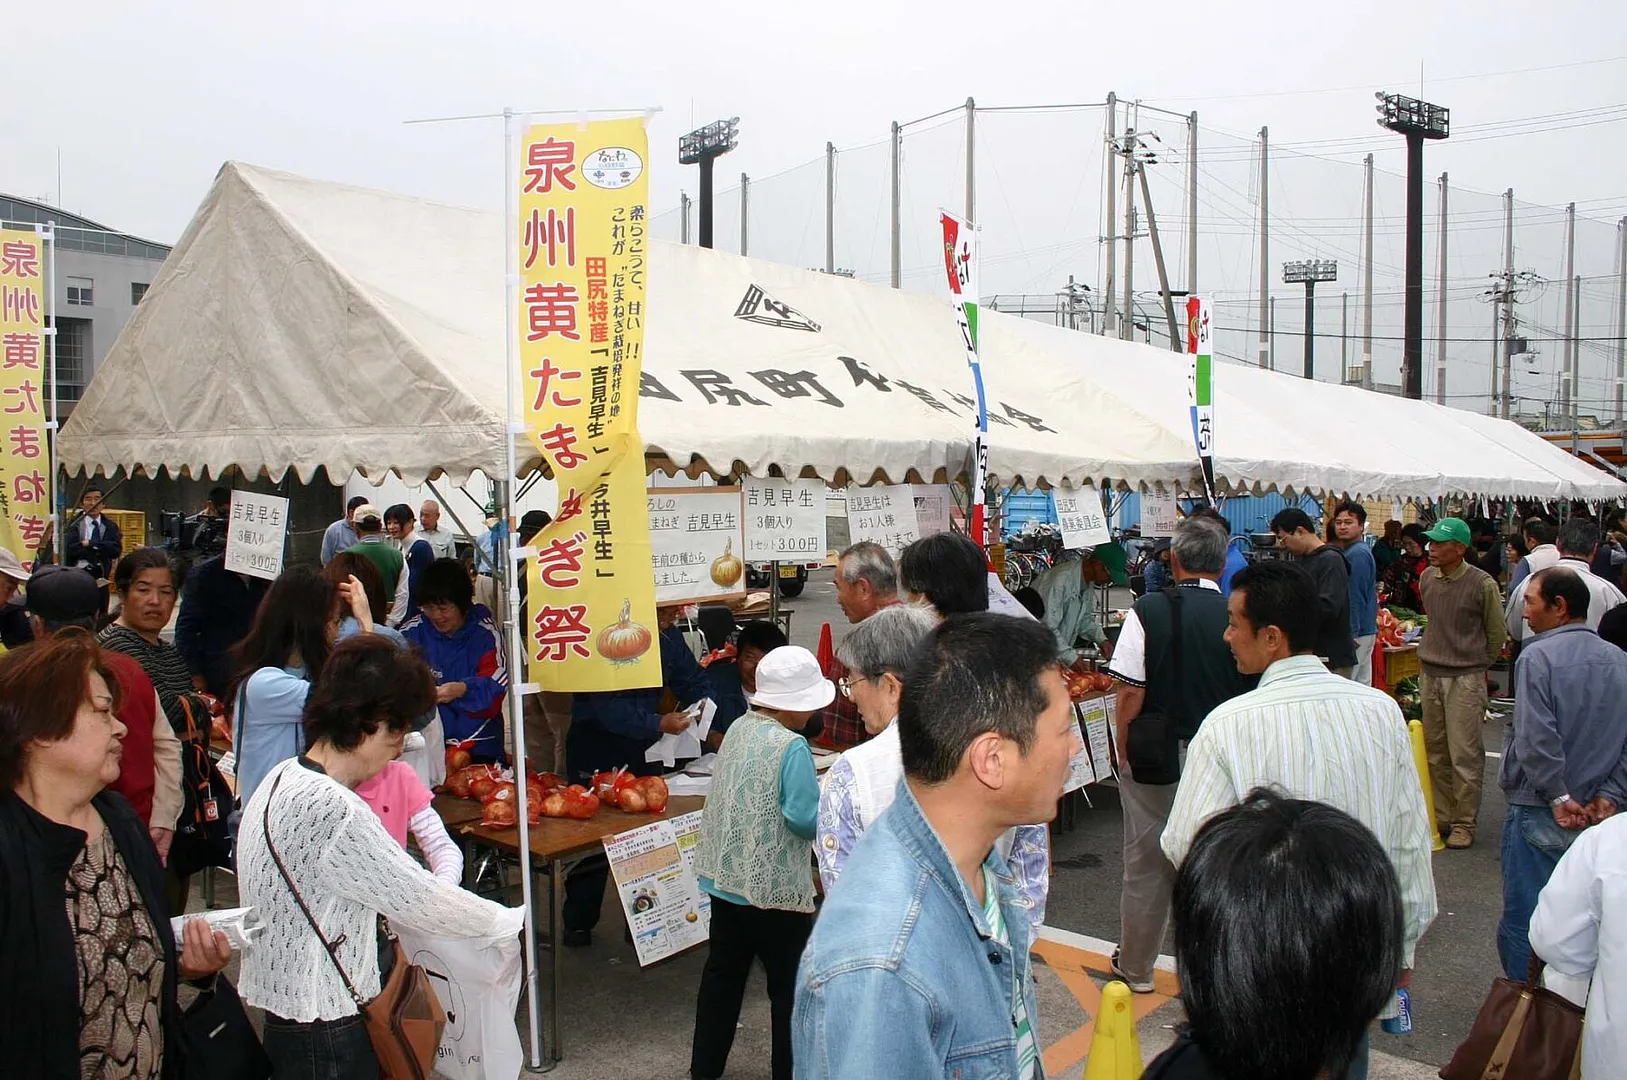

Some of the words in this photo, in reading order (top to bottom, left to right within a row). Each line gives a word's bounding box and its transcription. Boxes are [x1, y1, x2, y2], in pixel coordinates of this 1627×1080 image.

[747, 488, 814, 507] 吉見早生
[850, 495, 892, 510] 吉見早生は
[234, 501, 280, 526] 吉見早生
[687, 512, 736, 530] 吉見早生
[757, 515, 793, 529] 3個入り
[238, 530, 265, 547] 3個入り
